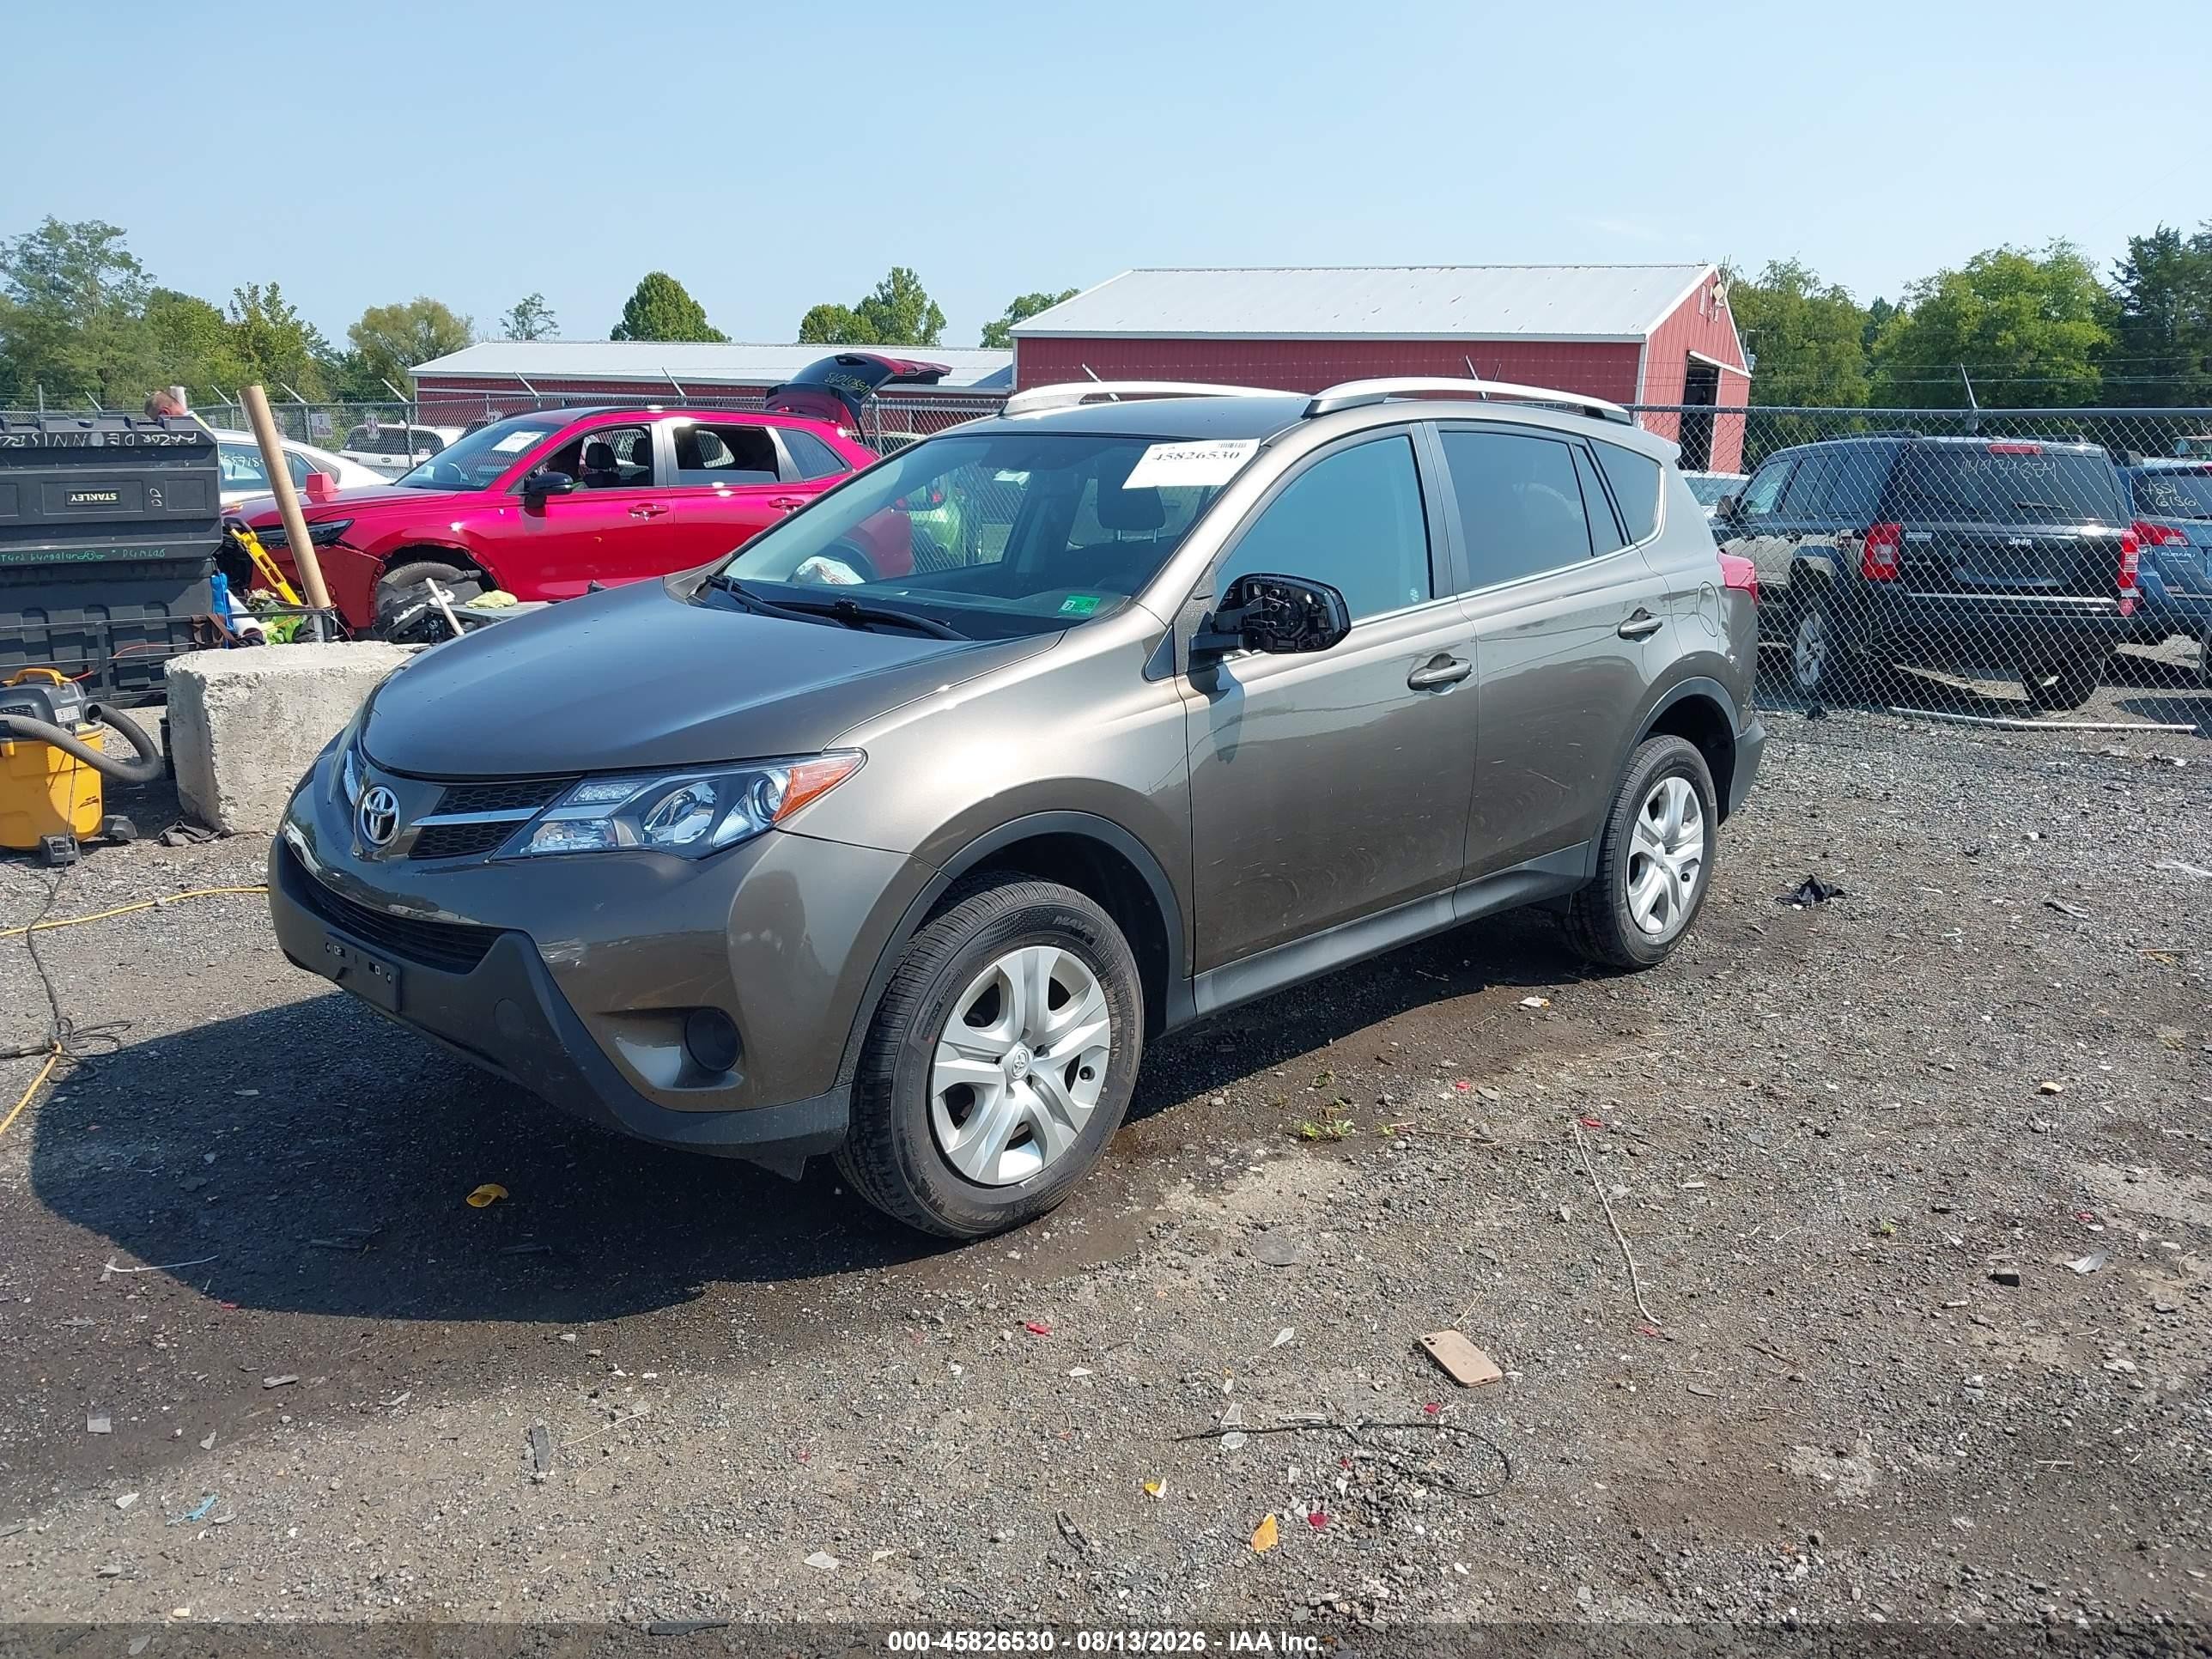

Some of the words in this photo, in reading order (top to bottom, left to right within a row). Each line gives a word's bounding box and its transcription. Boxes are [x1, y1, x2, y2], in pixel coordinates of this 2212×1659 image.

[1152, 451, 1240, 461] 45826530
[70, 491, 118, 501] STANLEY
[2008, 537, 2033, 546] Jeep
